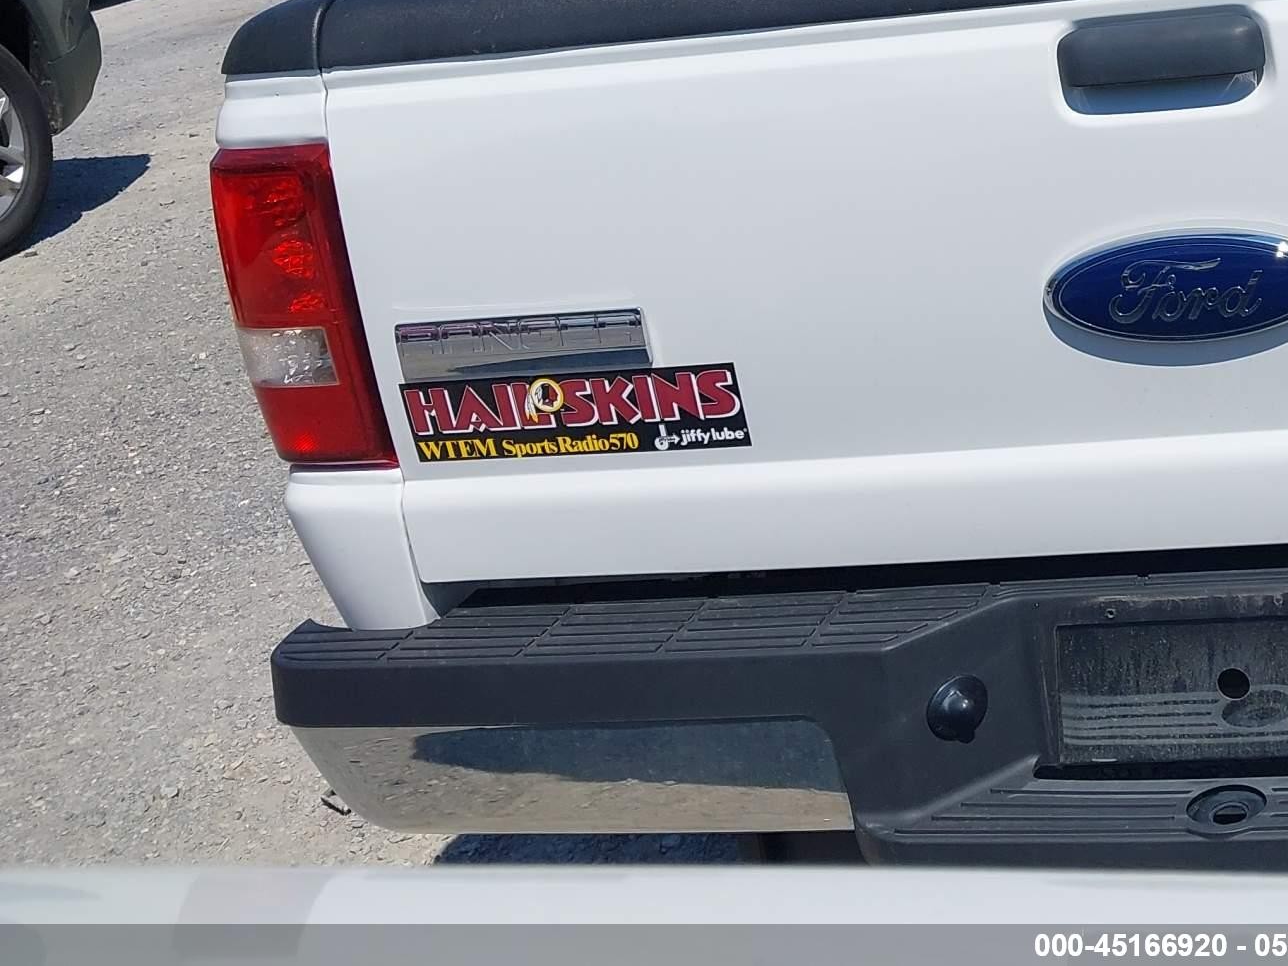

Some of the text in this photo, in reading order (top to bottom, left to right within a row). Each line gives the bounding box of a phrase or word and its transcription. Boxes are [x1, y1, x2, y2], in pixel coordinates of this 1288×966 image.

[1108, 257, 1264, 325] Ford
[558, 370, 741, 427] SKINS
[418, 438, 499, 461] WTEM
